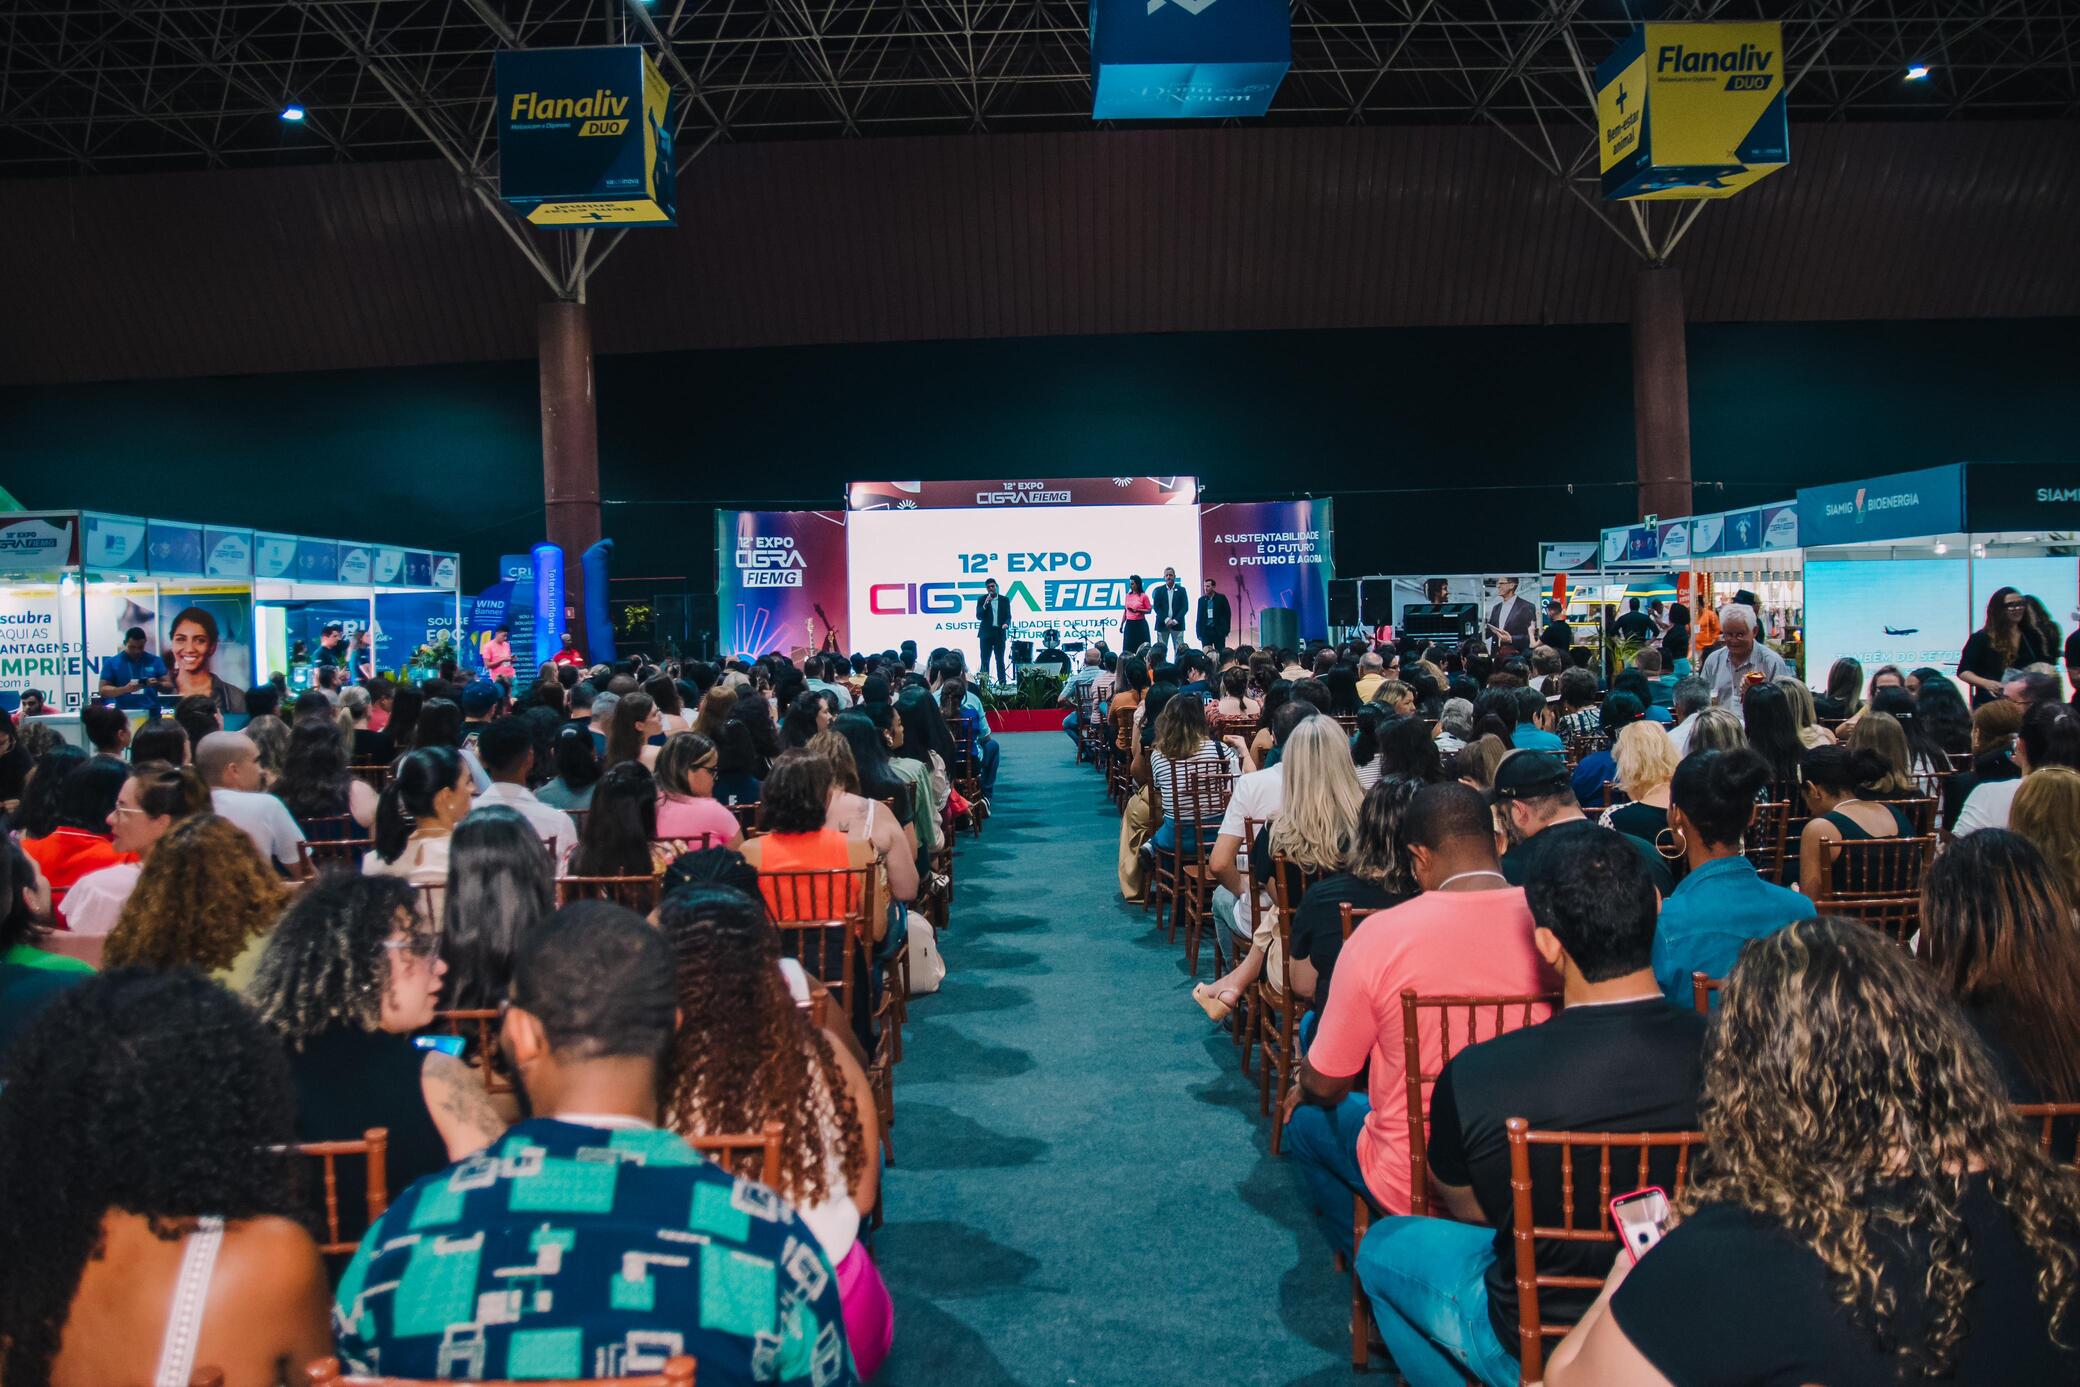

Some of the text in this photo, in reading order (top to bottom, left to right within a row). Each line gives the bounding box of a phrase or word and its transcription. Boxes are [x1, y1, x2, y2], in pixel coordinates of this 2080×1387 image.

[1656, 43, 1772, 73] Flanaliv
[1734, 77, 1765, 89] DUO
[511, 89, 629, 120] Flanaliv
[588, 122, 620, 135] DUO
[1018, 482, 1044, 490] EXPO
[976, 491, 1068, 504] CIGRA FIEMG
[1826, 493, 1920, 516] SIAMIG BIOENERGIA
[756, 536, 794, 548] EXPO
[1214, 531, 1319, 543] A SUSTENTABILIDADE
[1257, 542, 1315, 553] É O FUTURO
[735, 549, 808, 568] CIGRA
[958, 551, 1092, 573] 12ª EXPO
[1228, 552, 1322, 566] O FUTURO É AGORA
[548, 569, 557, 597] Totens
[746, 571, 797, 585] FIEMG
[476, 600, 504, 609] WIND
[427, 617, 452, 626] SOU
[935, 622, 942, 631] A
[0, 628, 48, 641] AQUI AS
[1896, 651, 1916, 663] DO
[24, 679, 31, 688] a
